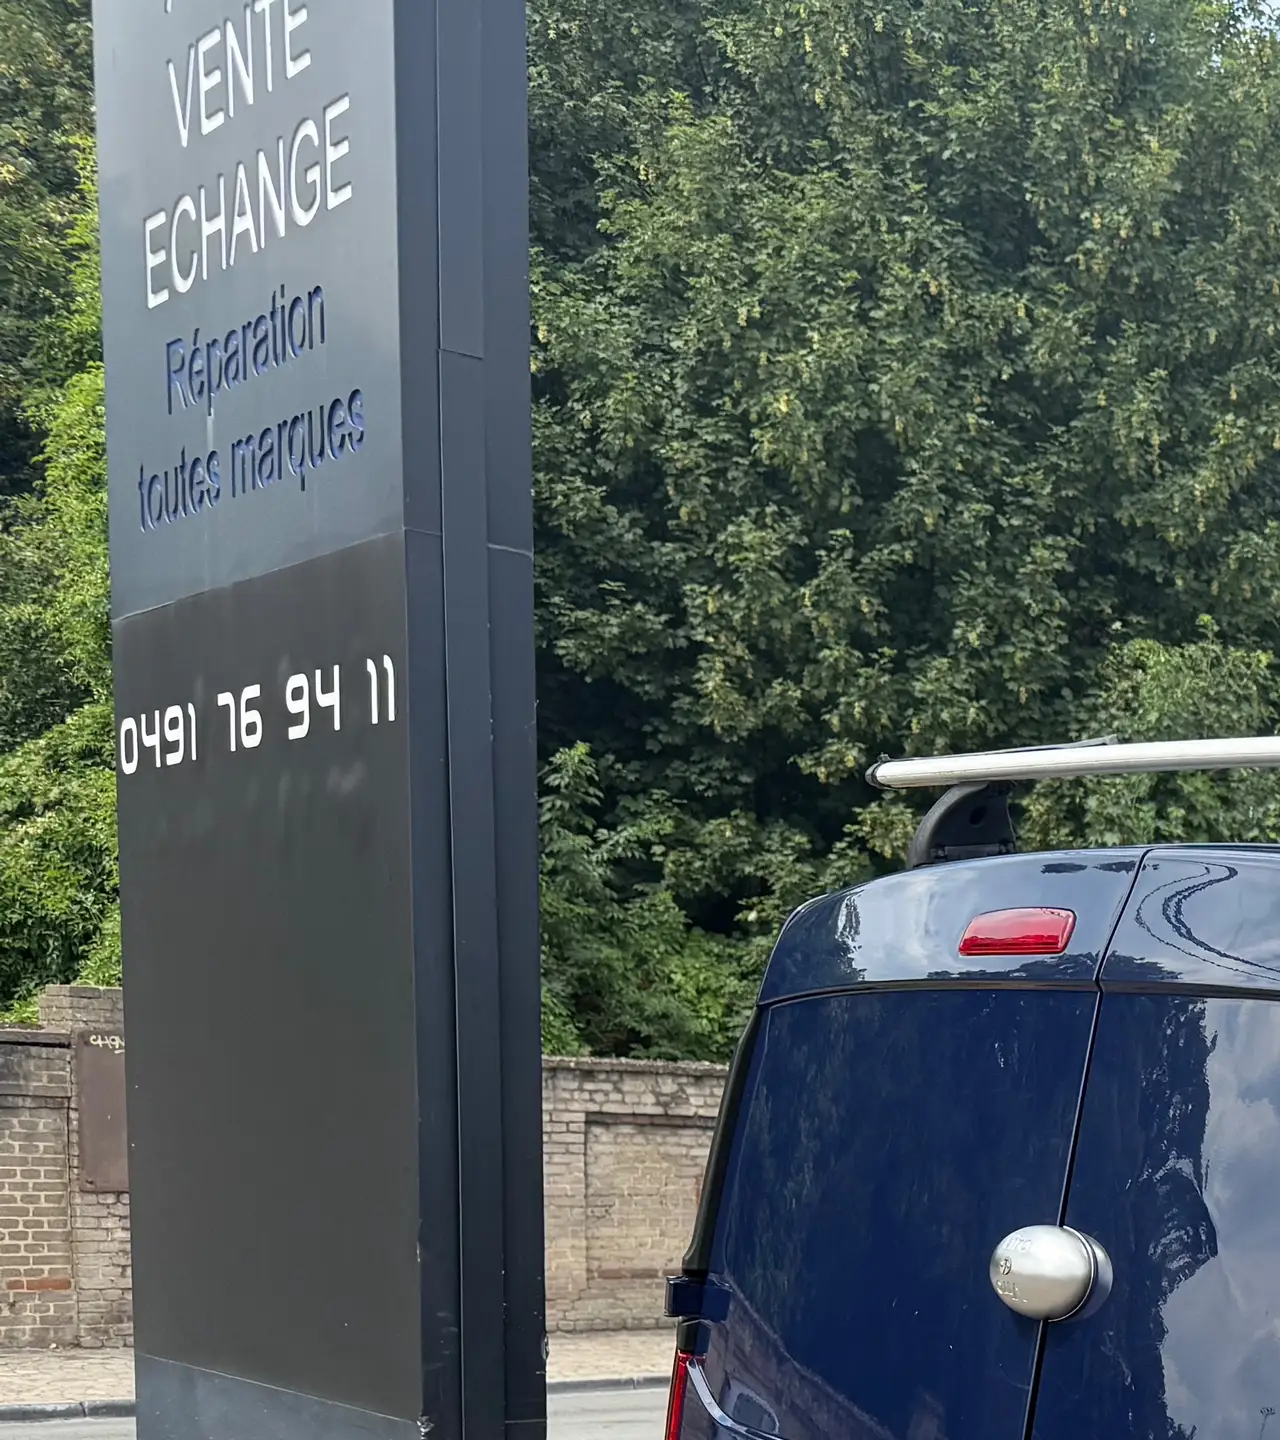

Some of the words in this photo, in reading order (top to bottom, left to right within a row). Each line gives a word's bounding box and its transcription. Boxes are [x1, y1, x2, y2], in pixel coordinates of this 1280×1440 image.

[165, 0, 312, 148] VENTE
[144, 93, 353, 309] ECHANGE
[166, 283, 326, 416] Réparation
[138, 445, 221, 533] toutes
[231, 388, 366, 492] marques
[120, 702, 197, 775] 0491
[217, 684, 263, 752] 76
[286, 665, 341, 741] 94
[366, 654, 396, 724] 11
